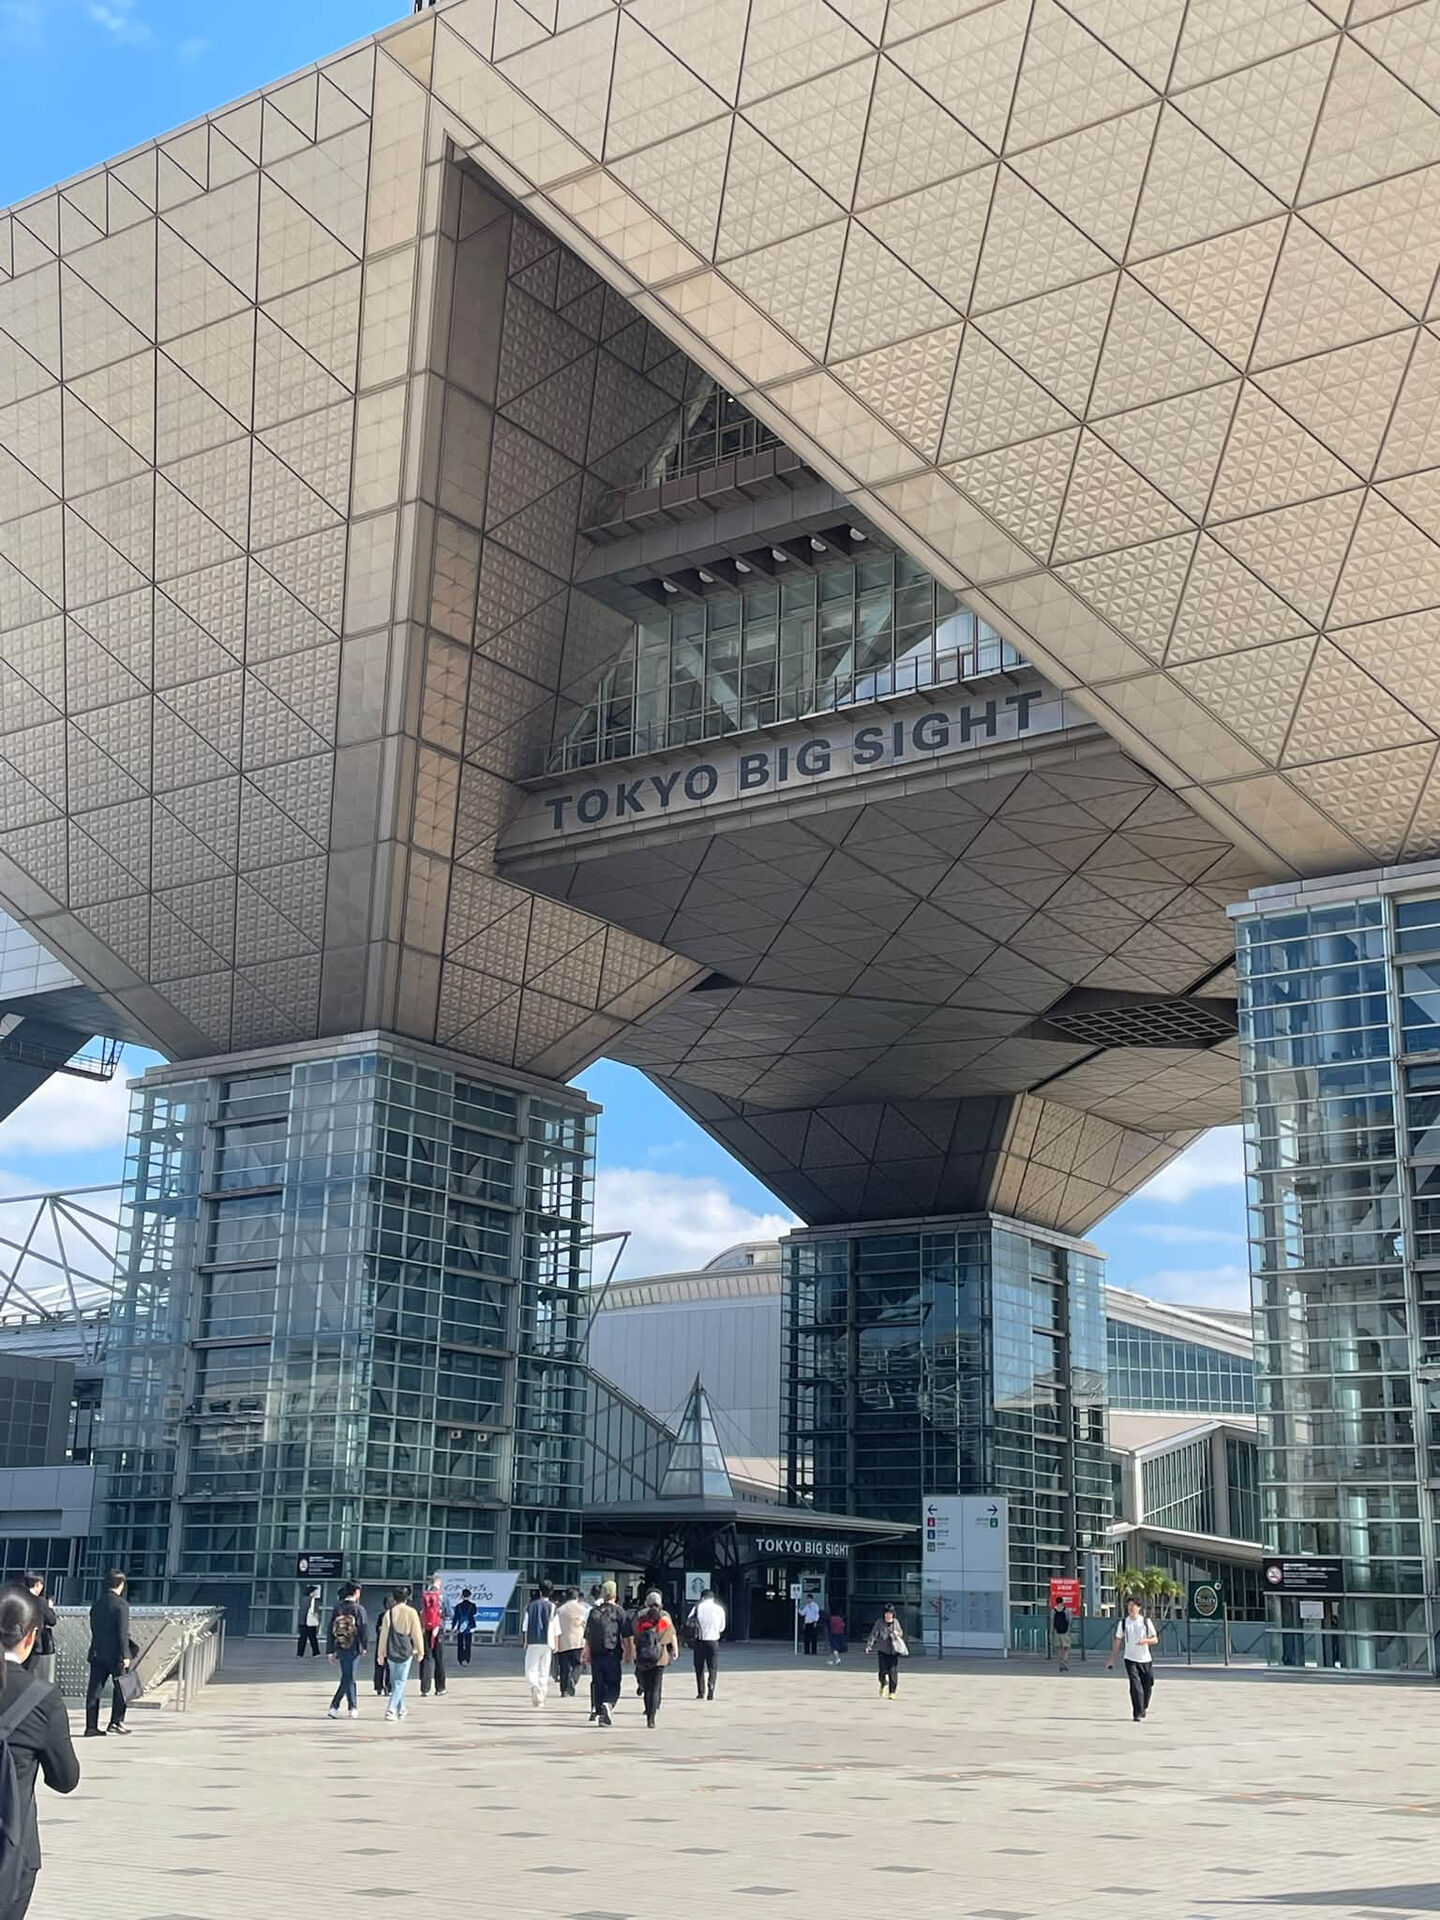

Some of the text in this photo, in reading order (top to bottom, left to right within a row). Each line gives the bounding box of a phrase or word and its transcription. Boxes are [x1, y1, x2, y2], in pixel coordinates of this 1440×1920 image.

[544, 690, 1042, 830] TOKYO BIG SIGHT
[755, 1538, 849, 1557] TOKYO BIG SIGHT
